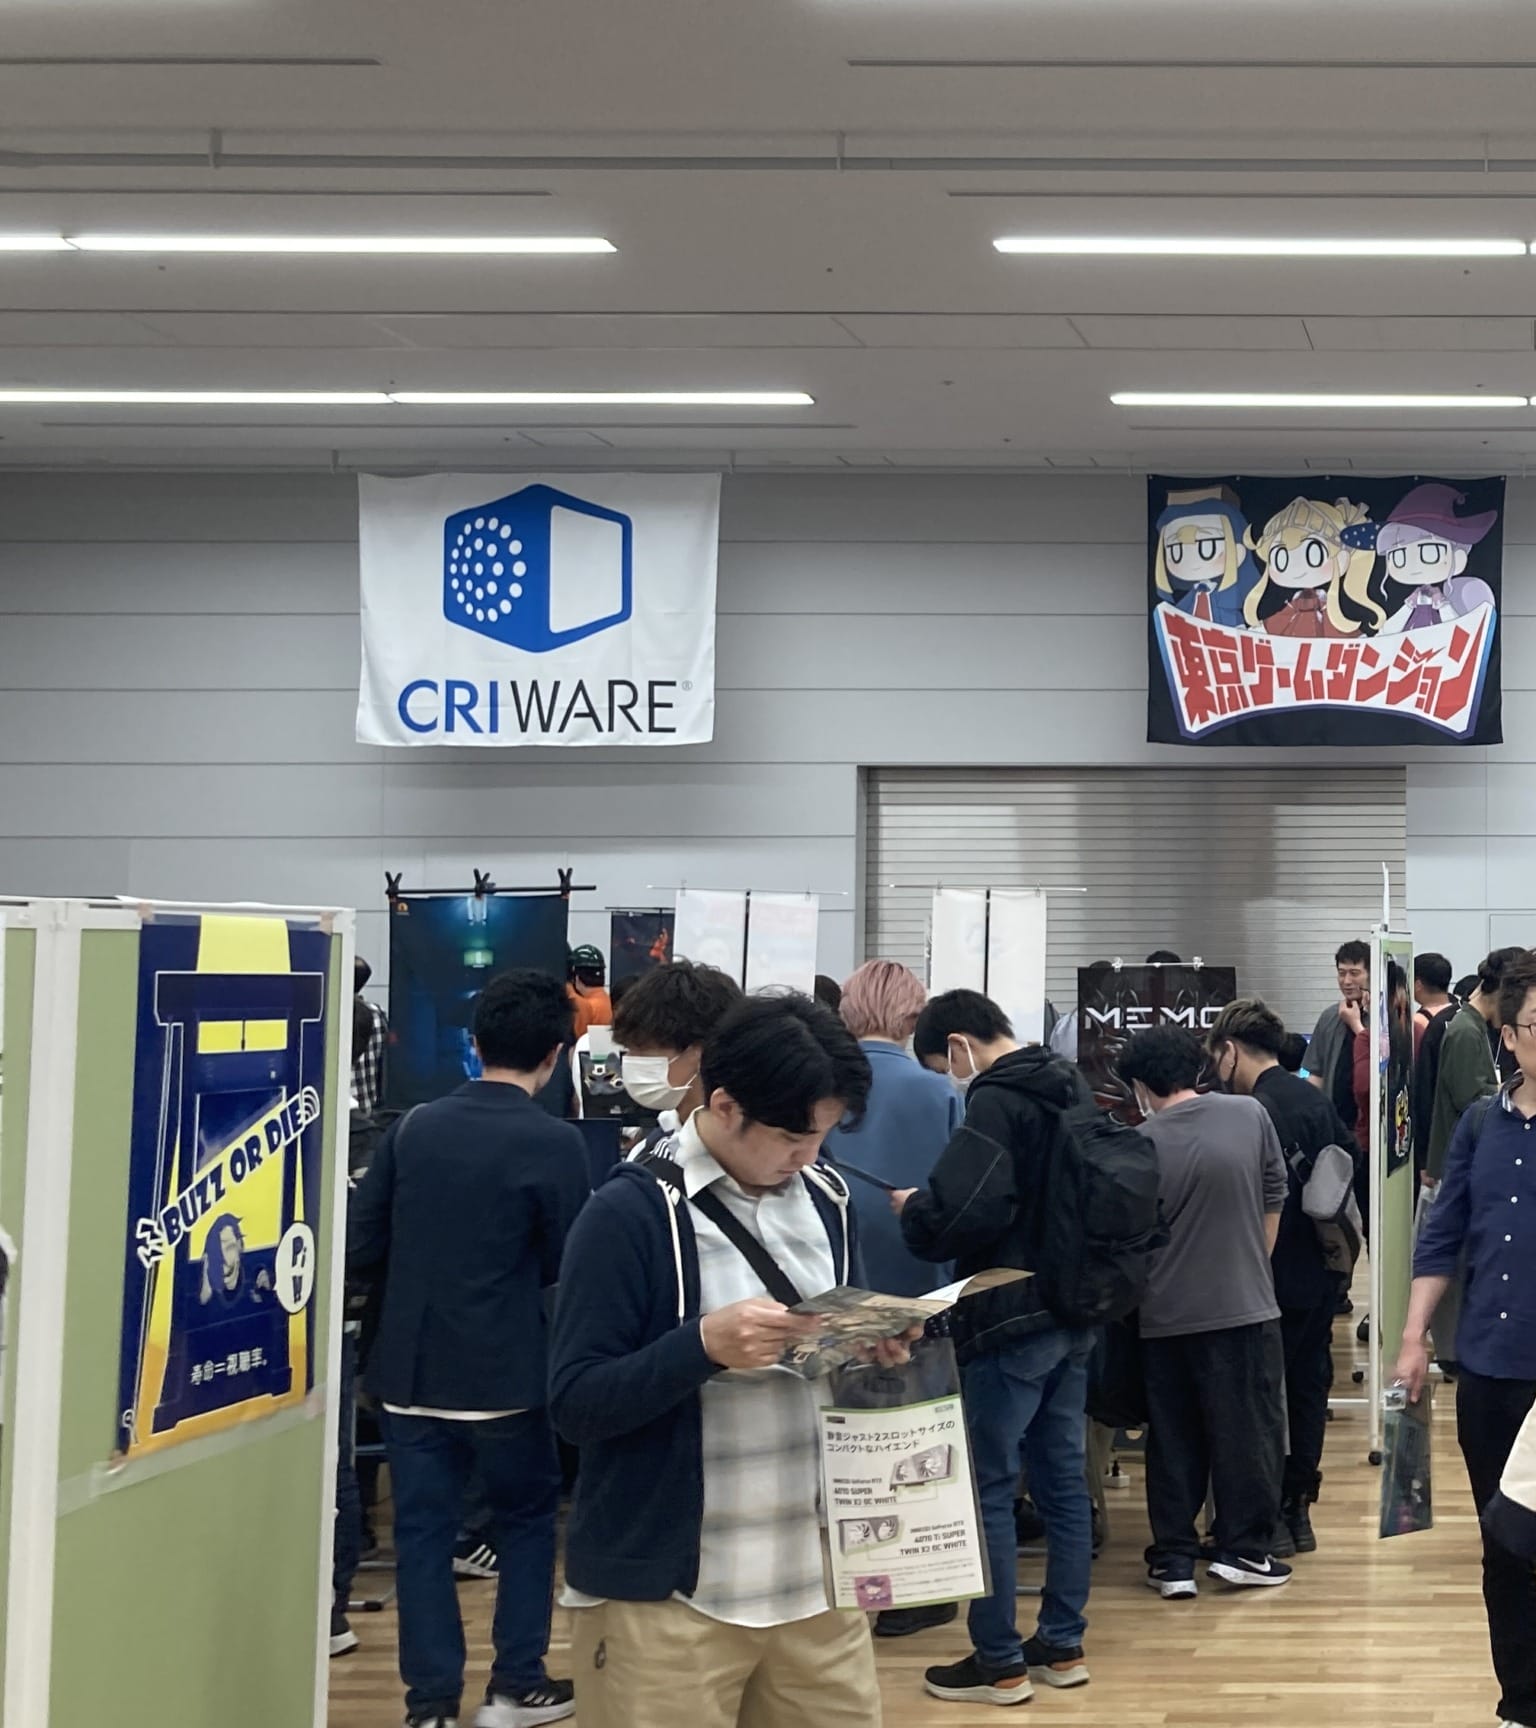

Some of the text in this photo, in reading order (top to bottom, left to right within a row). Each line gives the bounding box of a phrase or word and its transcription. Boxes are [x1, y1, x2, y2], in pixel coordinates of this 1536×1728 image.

[1166, 605, 1487, 727] 東京ゲームダンジョン
[160, 1097, 306, 1247] BUZZ OR DIE
[943, 1540, 967, 1550] WHITE
